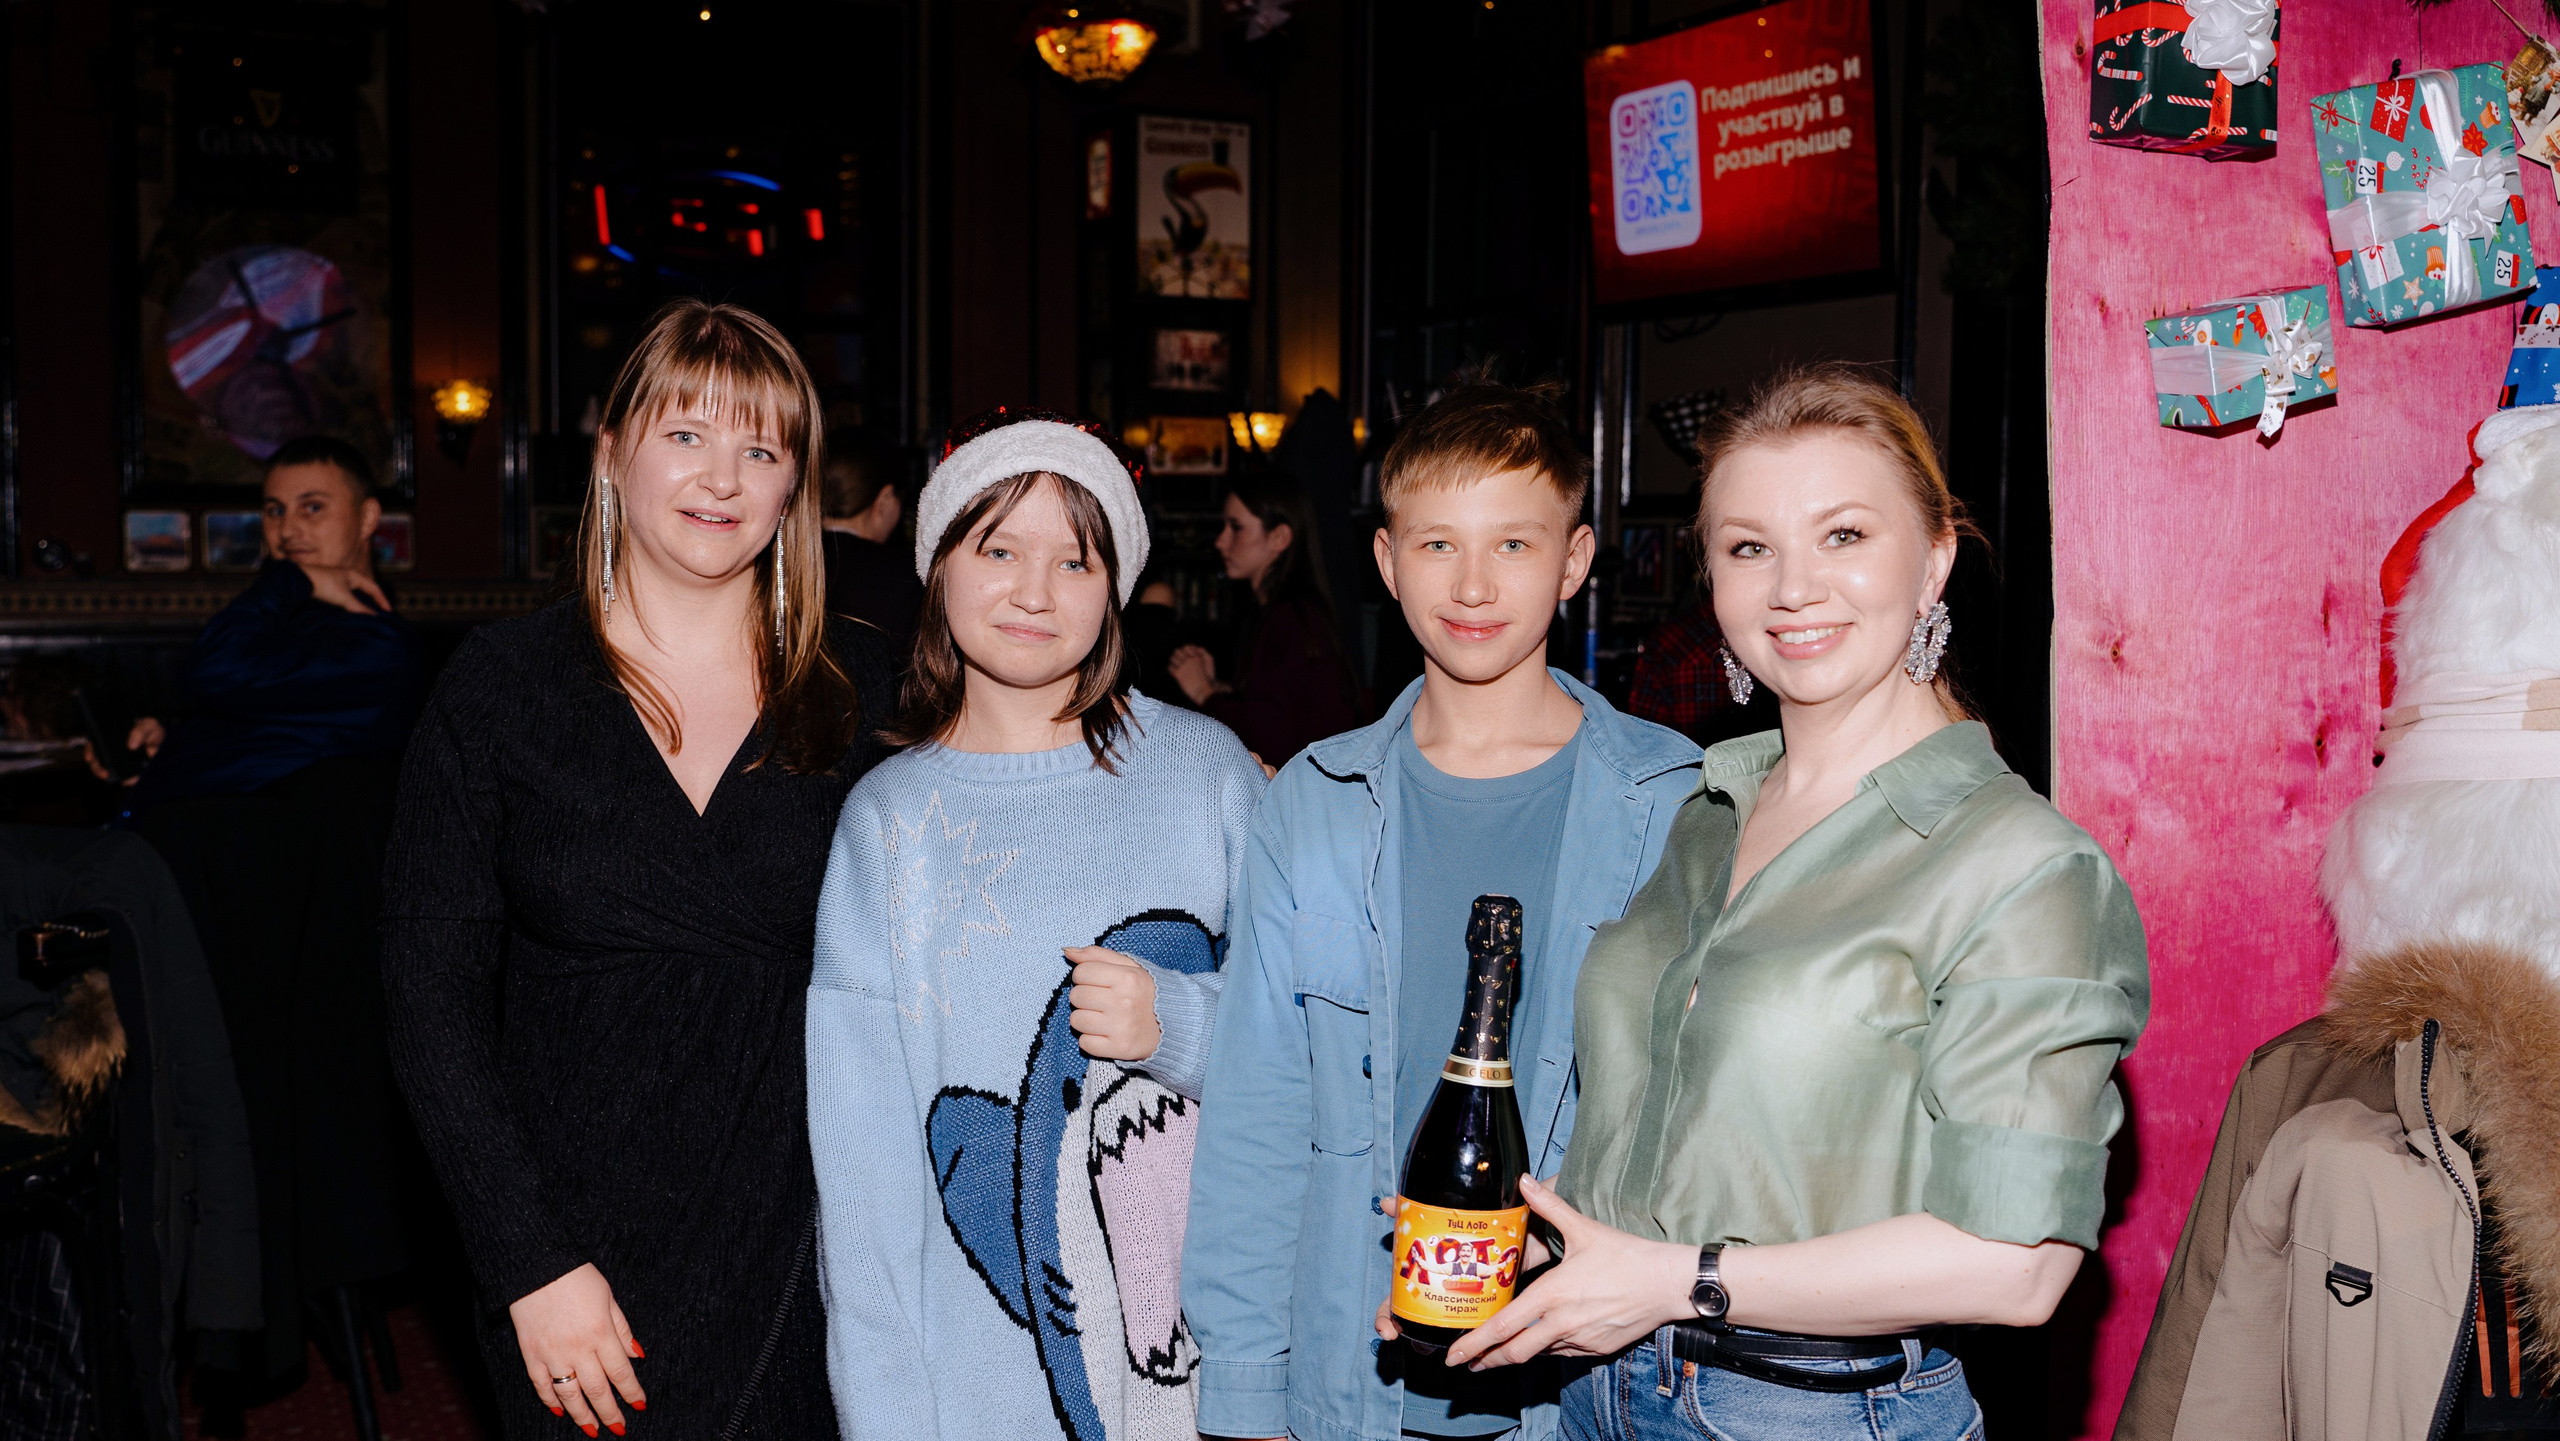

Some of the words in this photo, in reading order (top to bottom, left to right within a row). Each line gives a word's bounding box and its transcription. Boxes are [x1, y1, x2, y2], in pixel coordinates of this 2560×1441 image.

[1700, 63, 1839, 114] Подпишись
[1843, 55, 1861, 80] и
[1717, 92, 1824, 148] участвуй
[1829, 94, 1845, 118] в
[1713, 126, 1853, 181] розыгрыше
[2357, 165, 2377, 188] 25
[2496, 257, 2513, 280] 25
[1424, 1291, 1497, 1304] Классический
[1444, 1305, 1479, 1314] тираж
